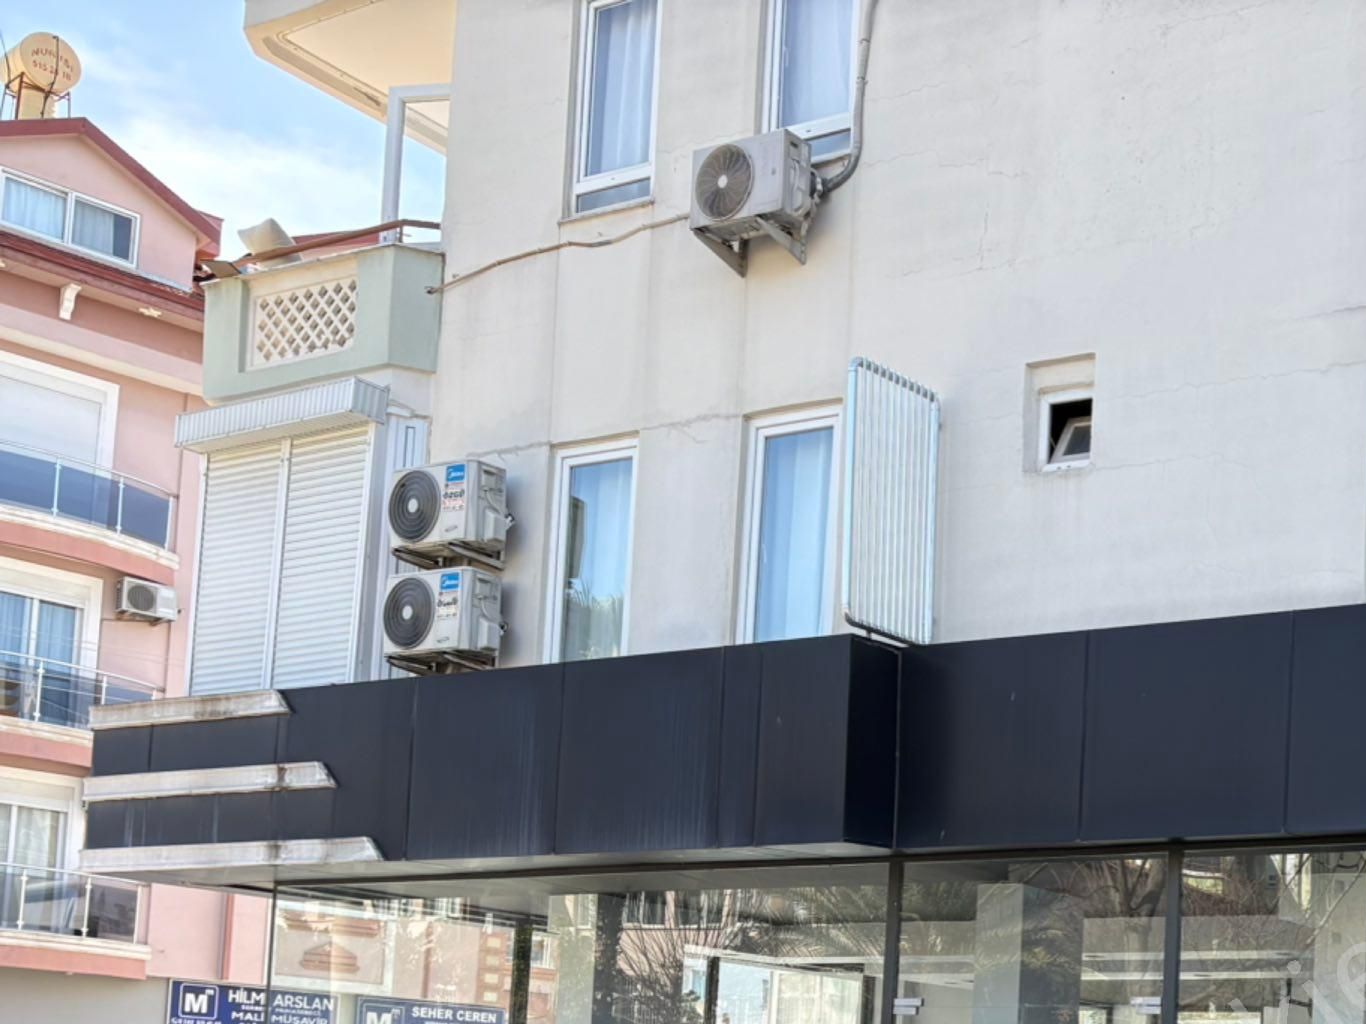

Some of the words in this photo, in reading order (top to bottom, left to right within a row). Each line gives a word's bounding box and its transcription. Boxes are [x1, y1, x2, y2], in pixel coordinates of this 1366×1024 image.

[228, 988, 270, 1005] HİLM
[273, 994, 334, 1011] ARSLAN
[231, 1010, 265, 1022] MALİ
[411, 1006, 453, 1020] SEHER
[456, 1009, 497, 1023] CEREN
